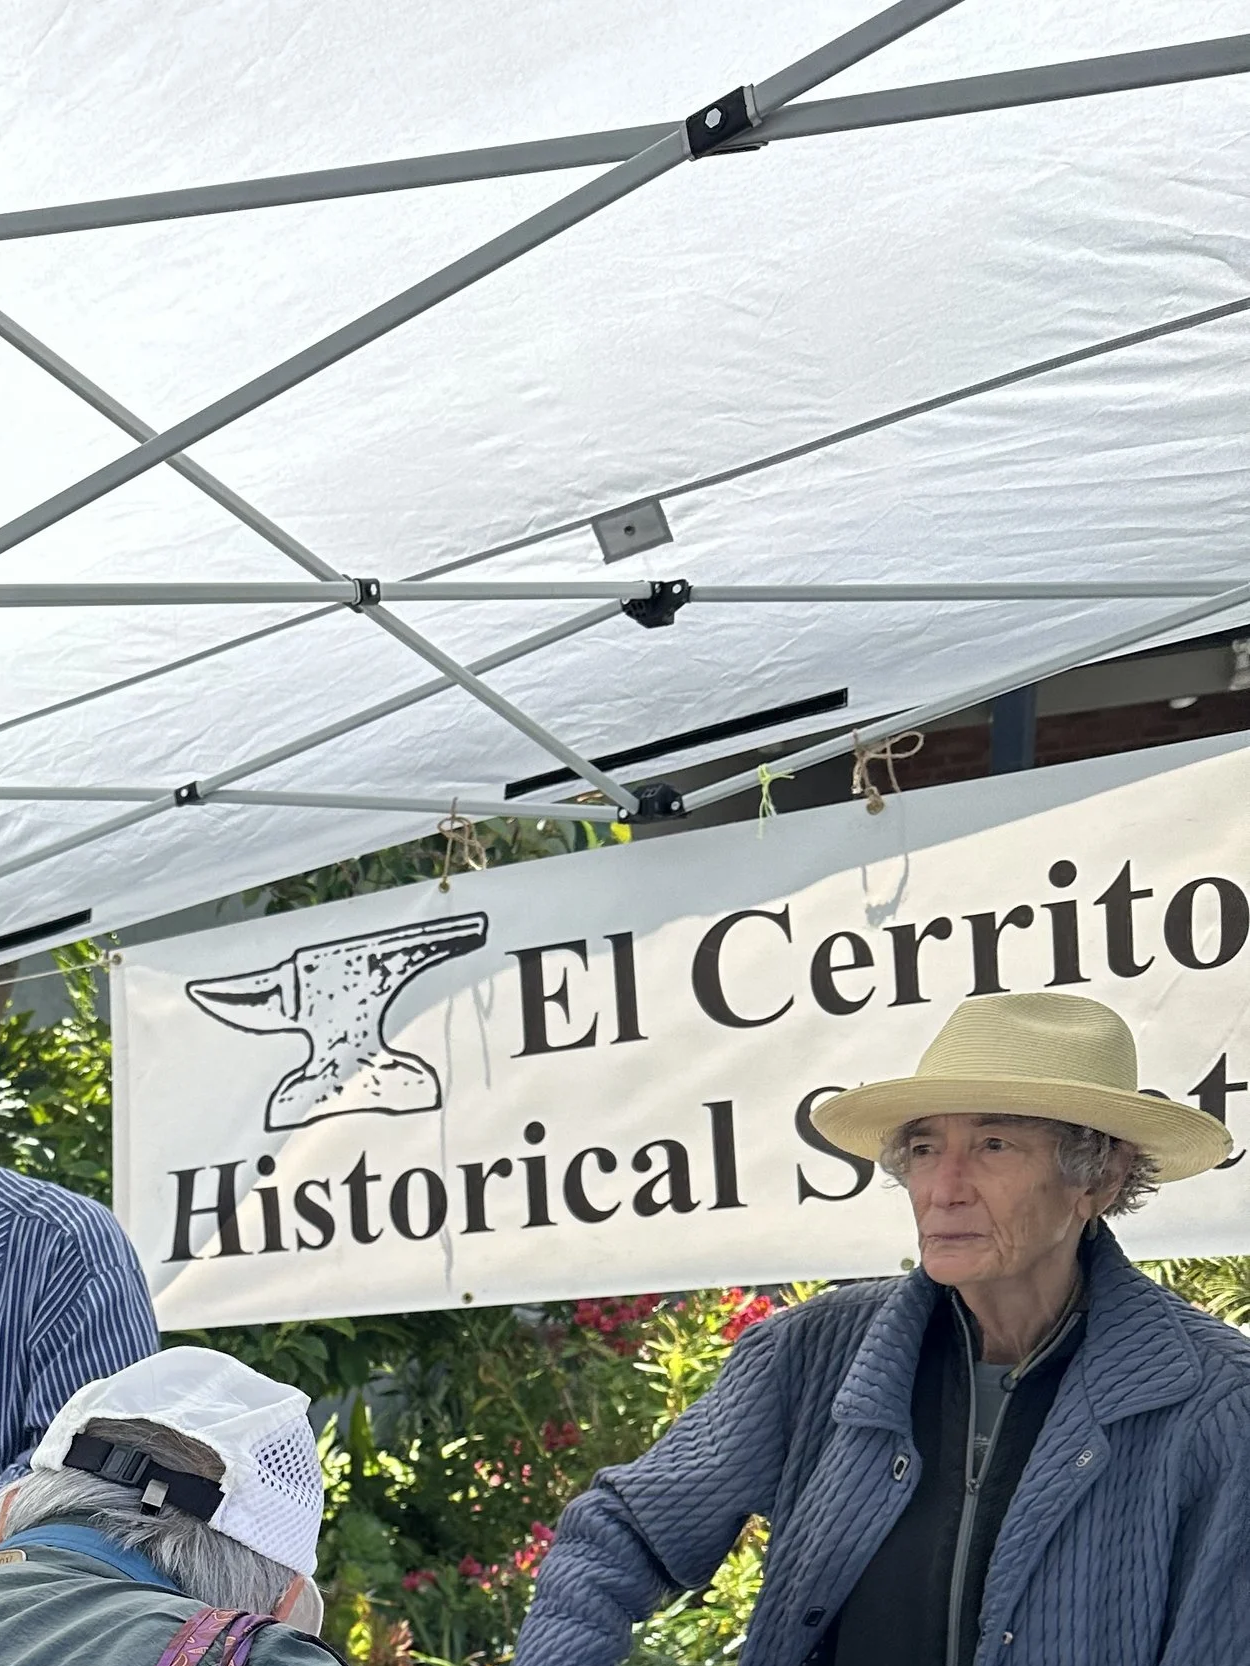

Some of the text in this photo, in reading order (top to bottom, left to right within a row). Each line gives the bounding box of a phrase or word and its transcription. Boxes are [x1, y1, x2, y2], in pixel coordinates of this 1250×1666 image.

[505, 860, 1250, 1058] El Cerrito
[162, 1101, 748, 1263] Historical
